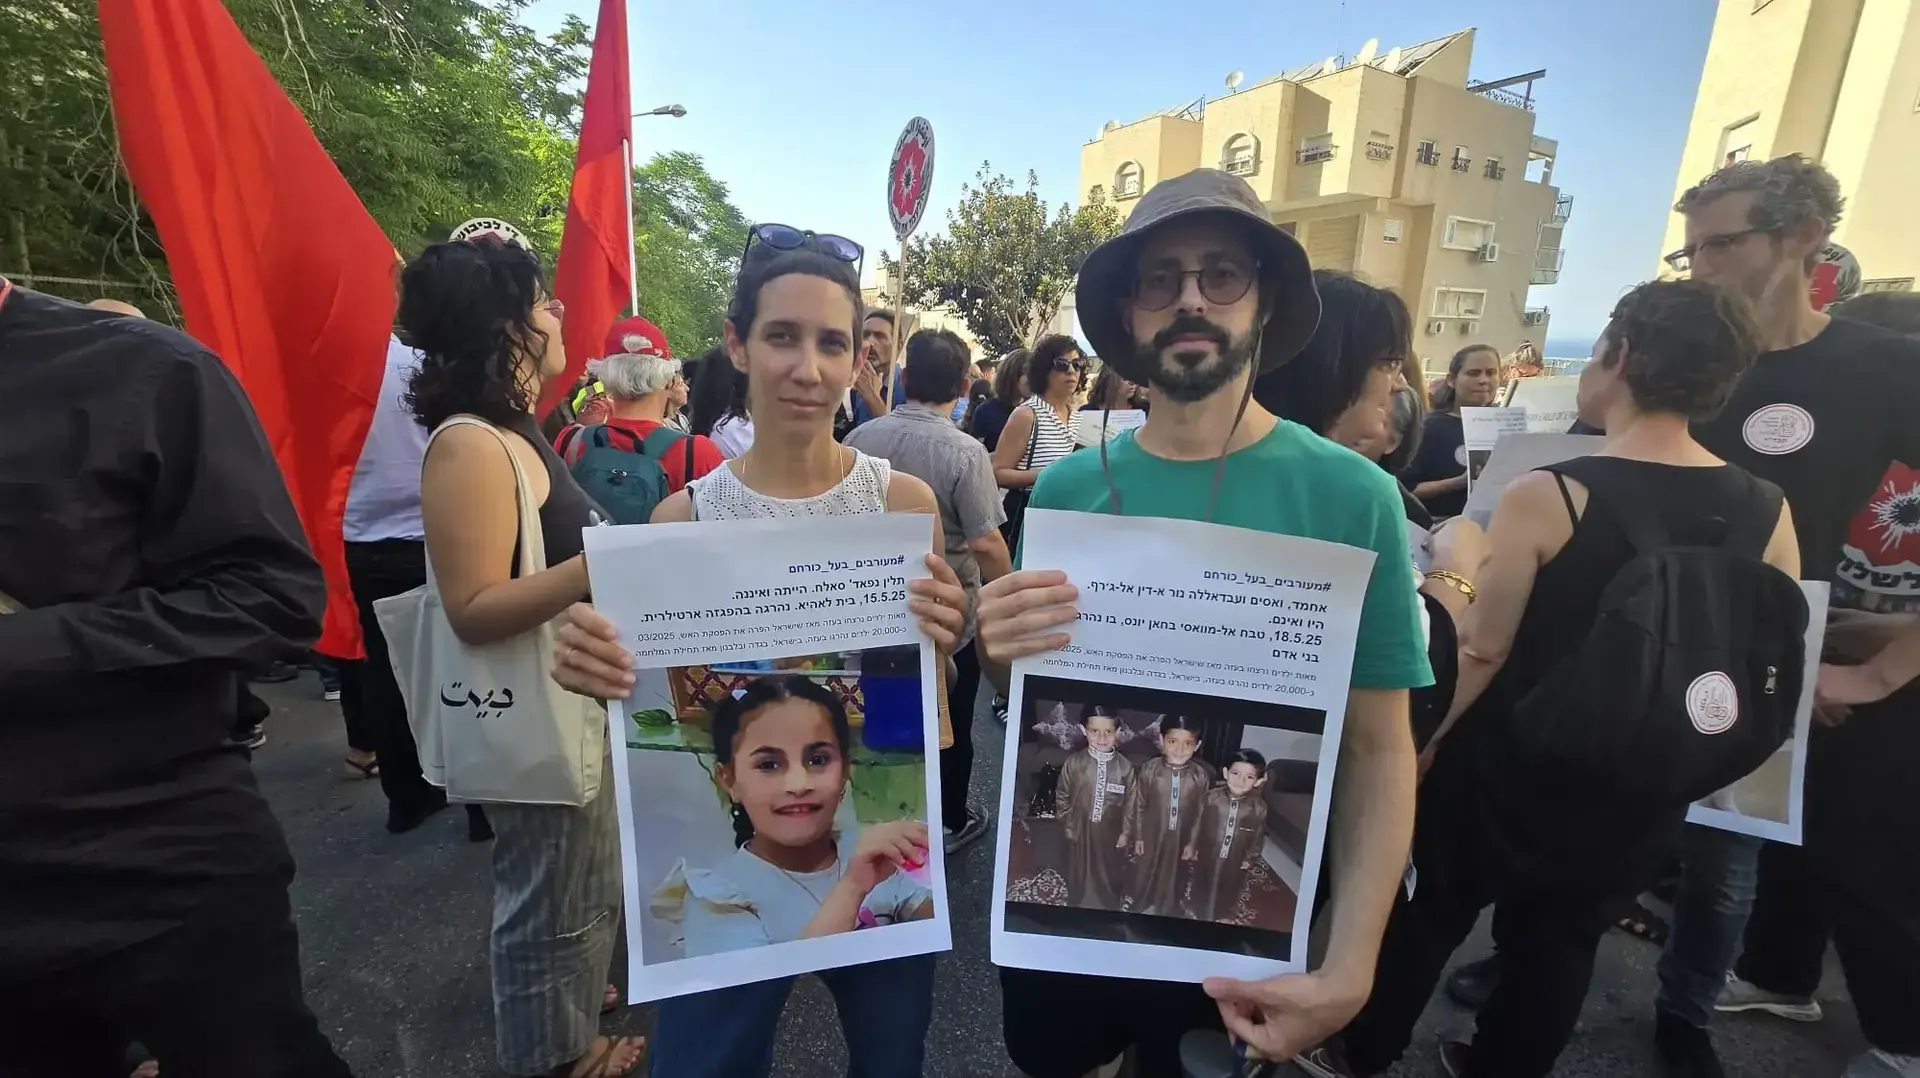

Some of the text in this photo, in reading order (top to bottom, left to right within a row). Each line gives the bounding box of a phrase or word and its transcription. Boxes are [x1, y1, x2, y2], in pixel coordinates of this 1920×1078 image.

[789, 555, 904, 573] #מעורבים_בעל_כורחם
[883, 576, 905, 589] תלין
[1203, 570, 1332, 592] #מעורבים_בעל_כורחם
[774, 585, 807, 596] הייתה
[811, 581, 846, 593] סאלח.
[1137, 585, 1165, 597] א-דין
[731, 588, 770, 600] ואיננה.
[1169, 588, 1185, 599] נור
[1188, 589, 1246, 605] ועבדאללה
[640, 590, 906, 623] 15.5.25, בית לאהיא. נהרגה בהפגזה ארטילרית.
[1250, 596, 1284, 608] ואסים
[1288, 600, 1328, 613] אחמד,
[844, 616, 865, 624] נרצחו
[867, 614, 886, 622] ילדים
[888, 612, 906, 620] מאות
[772, 623, 803, 631] שישראל
[823, 618, 842, 627] בעזה
[1268, 615, 1324, 630] היו ואינם.
[748, 626, 770, 635] הפרה
[872, 626, 907, 637] כ-20,000
[1075, 611, 1323, 646] 18.5.25, טבח אל-מוואסי בחאן יונס, בו נהרג
[702, 630, 731, 638] הפסקת
[829, 632, 849, 640] נהרגו
[851, 630, 870, 638] ילדים
[719, 642, 746, 653] ובלבנון
[748, 640, 769, 649] בגדה
[673, 646, 700, 655] תחילת
[1105, 651, 1133, 661] הפסקת
[1135, 653, 1147, 661] את
[1149, 655, 1171, 664] הפרה
[1272, 649, 1320, 663] בני אדם
[1076, 662, 1101, 671] תחילת
[1173, 657, 1205, 667] שישראל
[1206, 662, 1222, 670] מאז
[1103, 664, 1118, 673] מאז
[1119, 667, 1145, 676] ובלבנון
[1224, 664, 1244, 672] בעזה
[1247, 666, 1269, 674] נרצחו
[1271, 668, 1293, 677] ילדים
[1146, 670, 1167, 679] בגדה
[1294, 673, 1317, 682] מאות
[1228, 679, 1249, 688] נהרגו
[1251, 682, 1273, 691] ילדים
[1274, 684, 1315, 696] כ-20,000
